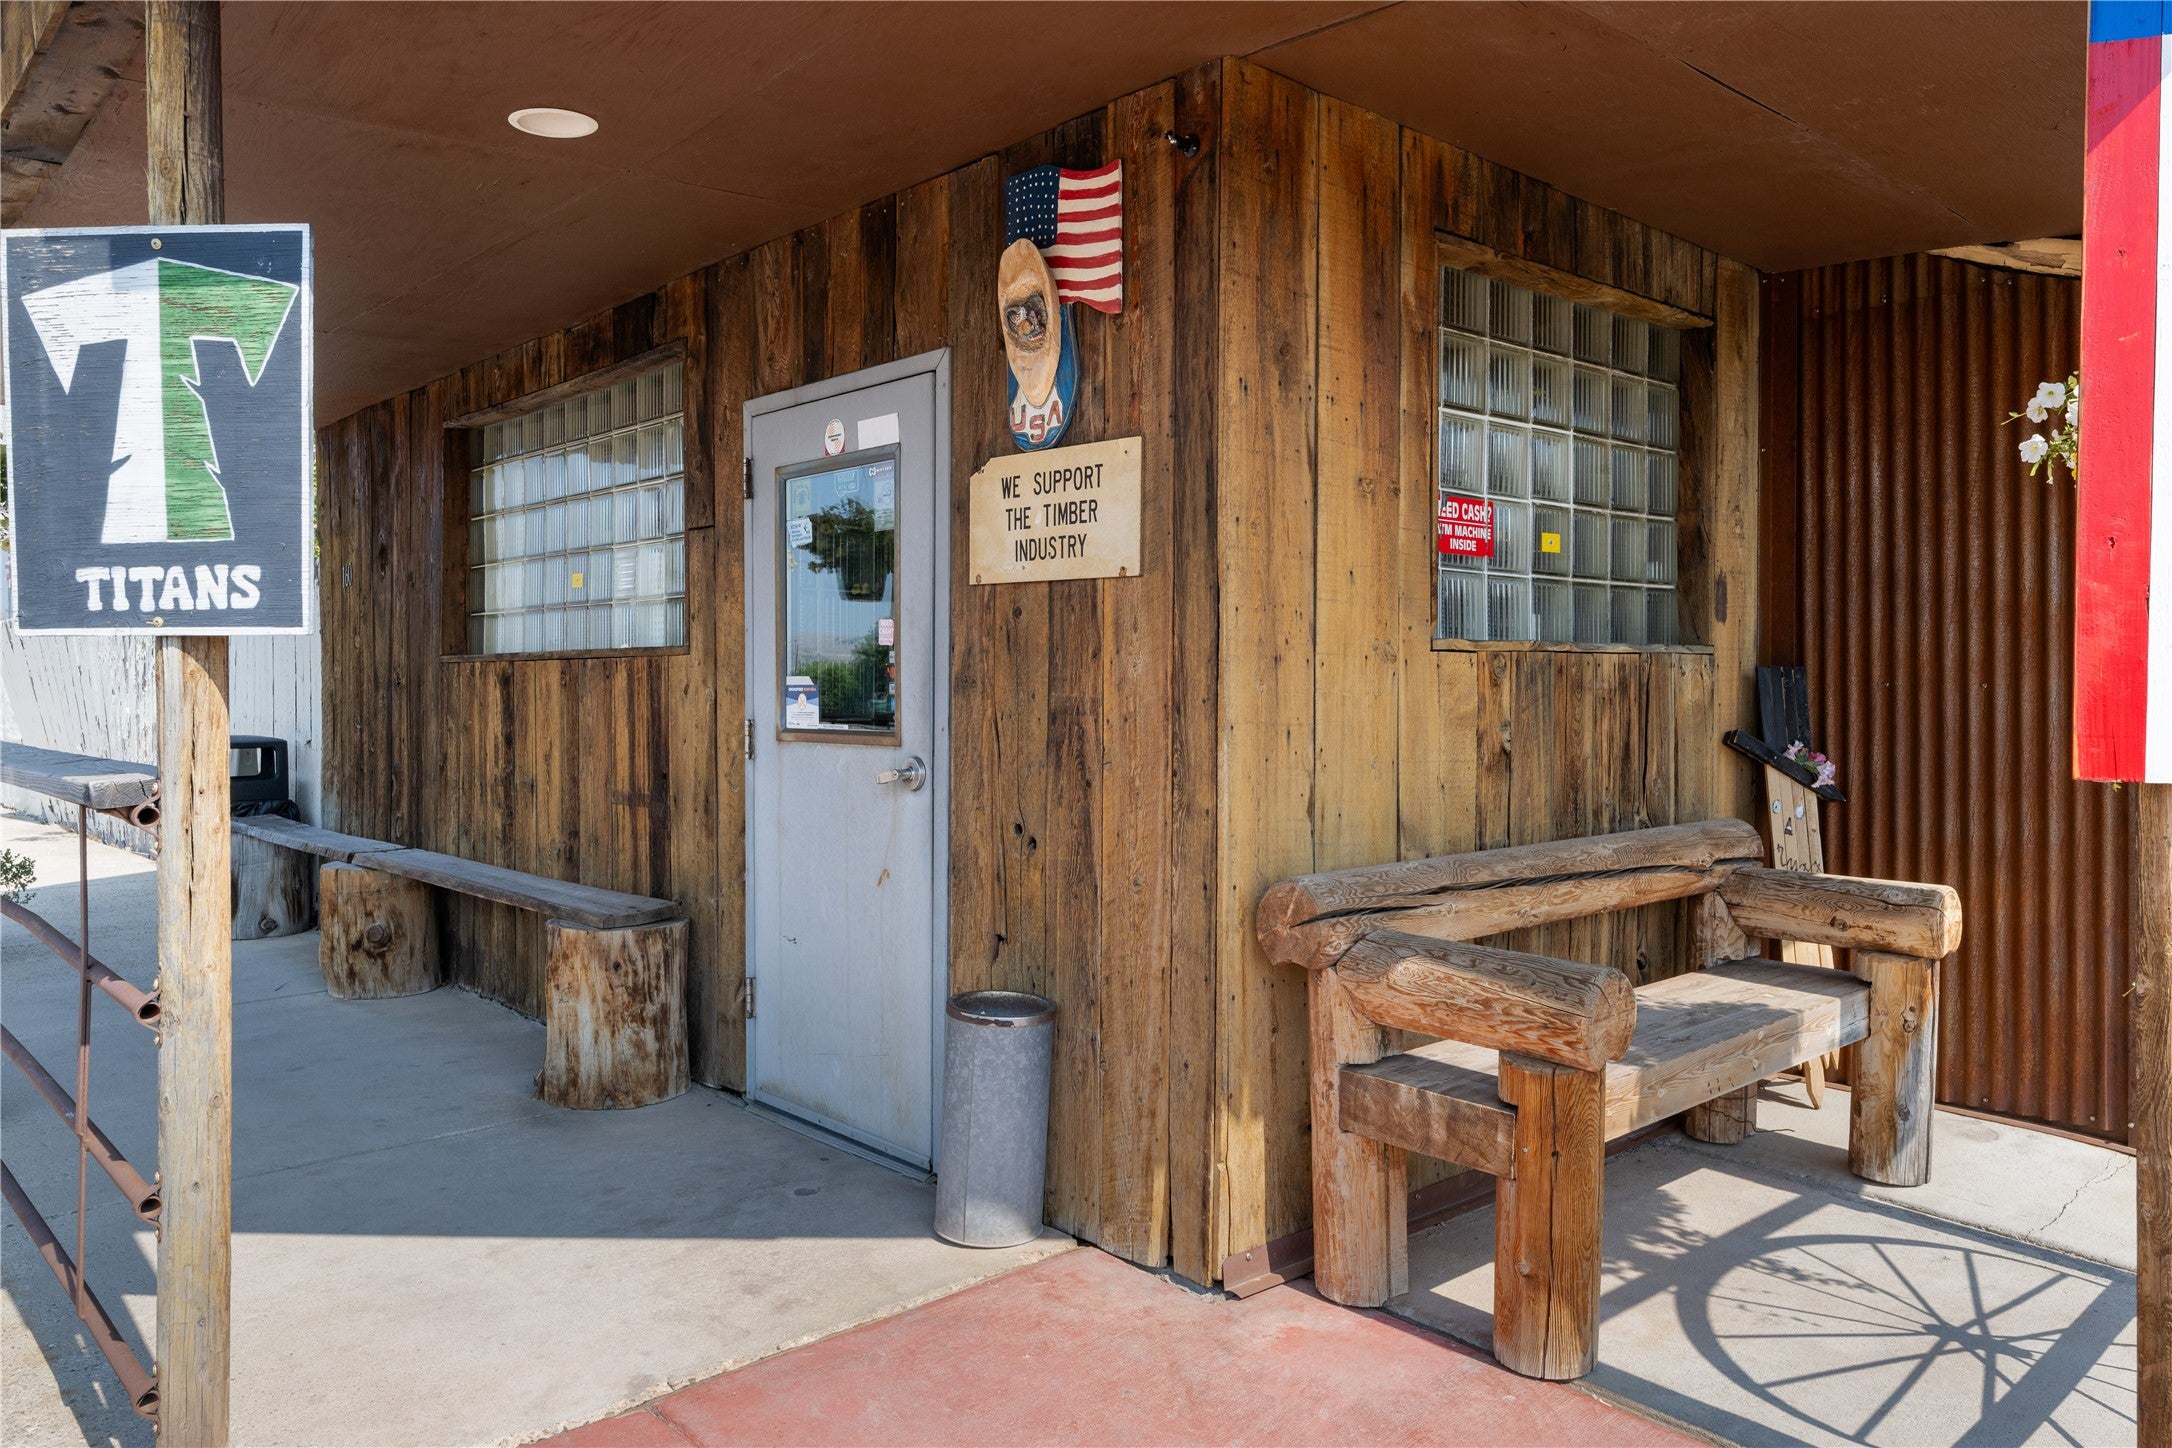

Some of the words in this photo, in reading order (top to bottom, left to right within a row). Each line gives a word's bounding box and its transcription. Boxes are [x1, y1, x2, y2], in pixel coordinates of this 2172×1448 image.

[1010, 400, 1062, 441] USA
[1001, 475, 1020, 499] WE
[1033, 463, 1104, 496] SUPPORT
[1005, 506, 1031, 531] THE
[1043, 499, 1098, 527] TIMBER
[1438, 500, 1459, 518] EED
[1462, 503, 1492, 522] CASH?
[1450, 538, 1477, 551] INSIDE
[1454, 525, 1491, 539] MACHINE
[1015, 533, 1087, 562] INDUSTRY
[75, 564, 262, 612] TITANS
